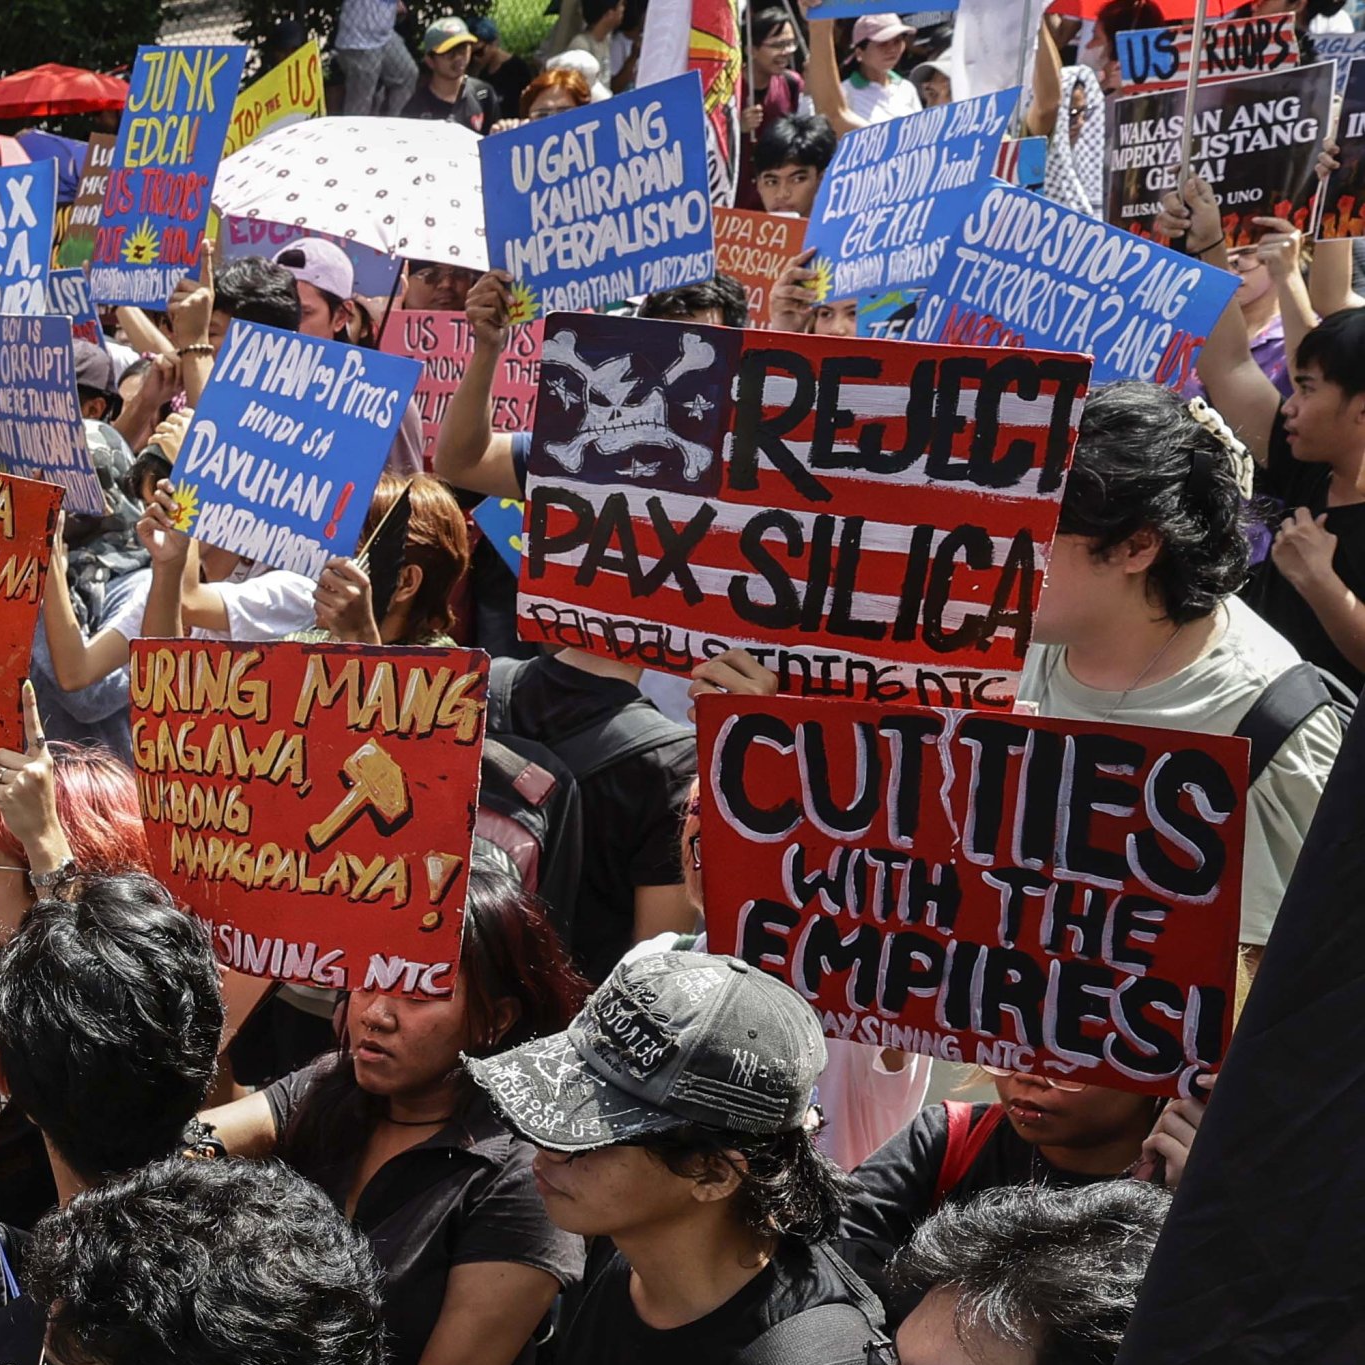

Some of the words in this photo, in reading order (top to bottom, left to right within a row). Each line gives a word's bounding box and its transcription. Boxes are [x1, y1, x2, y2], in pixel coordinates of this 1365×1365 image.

[129, 49, 229, 113] JUNK
[265, 91, 281, 117] THE
[287, 53, 318, 108] US
[1126, 30, 1179, 84] US
[125, 112, 200, 166] EDCA!
[834, 127, 887, 177] LIBRO
[893, 105, 947, 157] HINDI
[1229, 96, 1301, 131] ANG
[511, 119, 600, 193] UGAT
[615, 101, 667, 154] NG
[930, 138, 985, 196] hindi
[1146, 159, 1227, 192] GEA!
[104, 168, 135, 219] US
[139, 168, 208, 221] TROOPS
[530, 141, 683, 233] KAHIRAPAN
[1226, 188, 1264, 206] UNO
[94, 228, 125, 264] OUT
[158, 228, 203, 268] NOW
[505, 190, 707, 280] IMPERYALISMO
[756, 220, 788, 250] SA
[840, 196, 935, 259] GYERA!
[541, 270, 635, 313] KABATAAN
[639, 249, 715, 293] PARTYLIST
[1132, 257, 1201, 322] ANG
[2, 320, 21, 343] BOY
[27, 319, 41, 344] IS
[404, 316, 439, 353] US
[947, 246, 1125, 355] TERRORISTA?
[1102, 320, 1172, 381] ANG
[215, 323, 314, 402] YAMAN
[28, 388, 75, 422] TALKING
[239, 400, 305, 446] HINDI
[302, 428, 335, 460] SA
[727, 347, 1092, 502] REJECT
[527, 485, 718, 606] PAX
[729, 508, 1034, 660] SILICA
[131, 648, 272, 724] URING
[293, 653, 487, 745] MANG
[132, 718, 314, 798] GAGAWA,
[782, 842, 963, 936] WITH
[981, 866, 1173, 976] THE
[217, 923, 349, 991] SINING
[362, 952, 454, 998] NTC
[733, 898, 1227, 1100] EMPIRES!
[860, 1014, 964, 1065] SINING
[975, 1039, 1037, 1074] NTC
